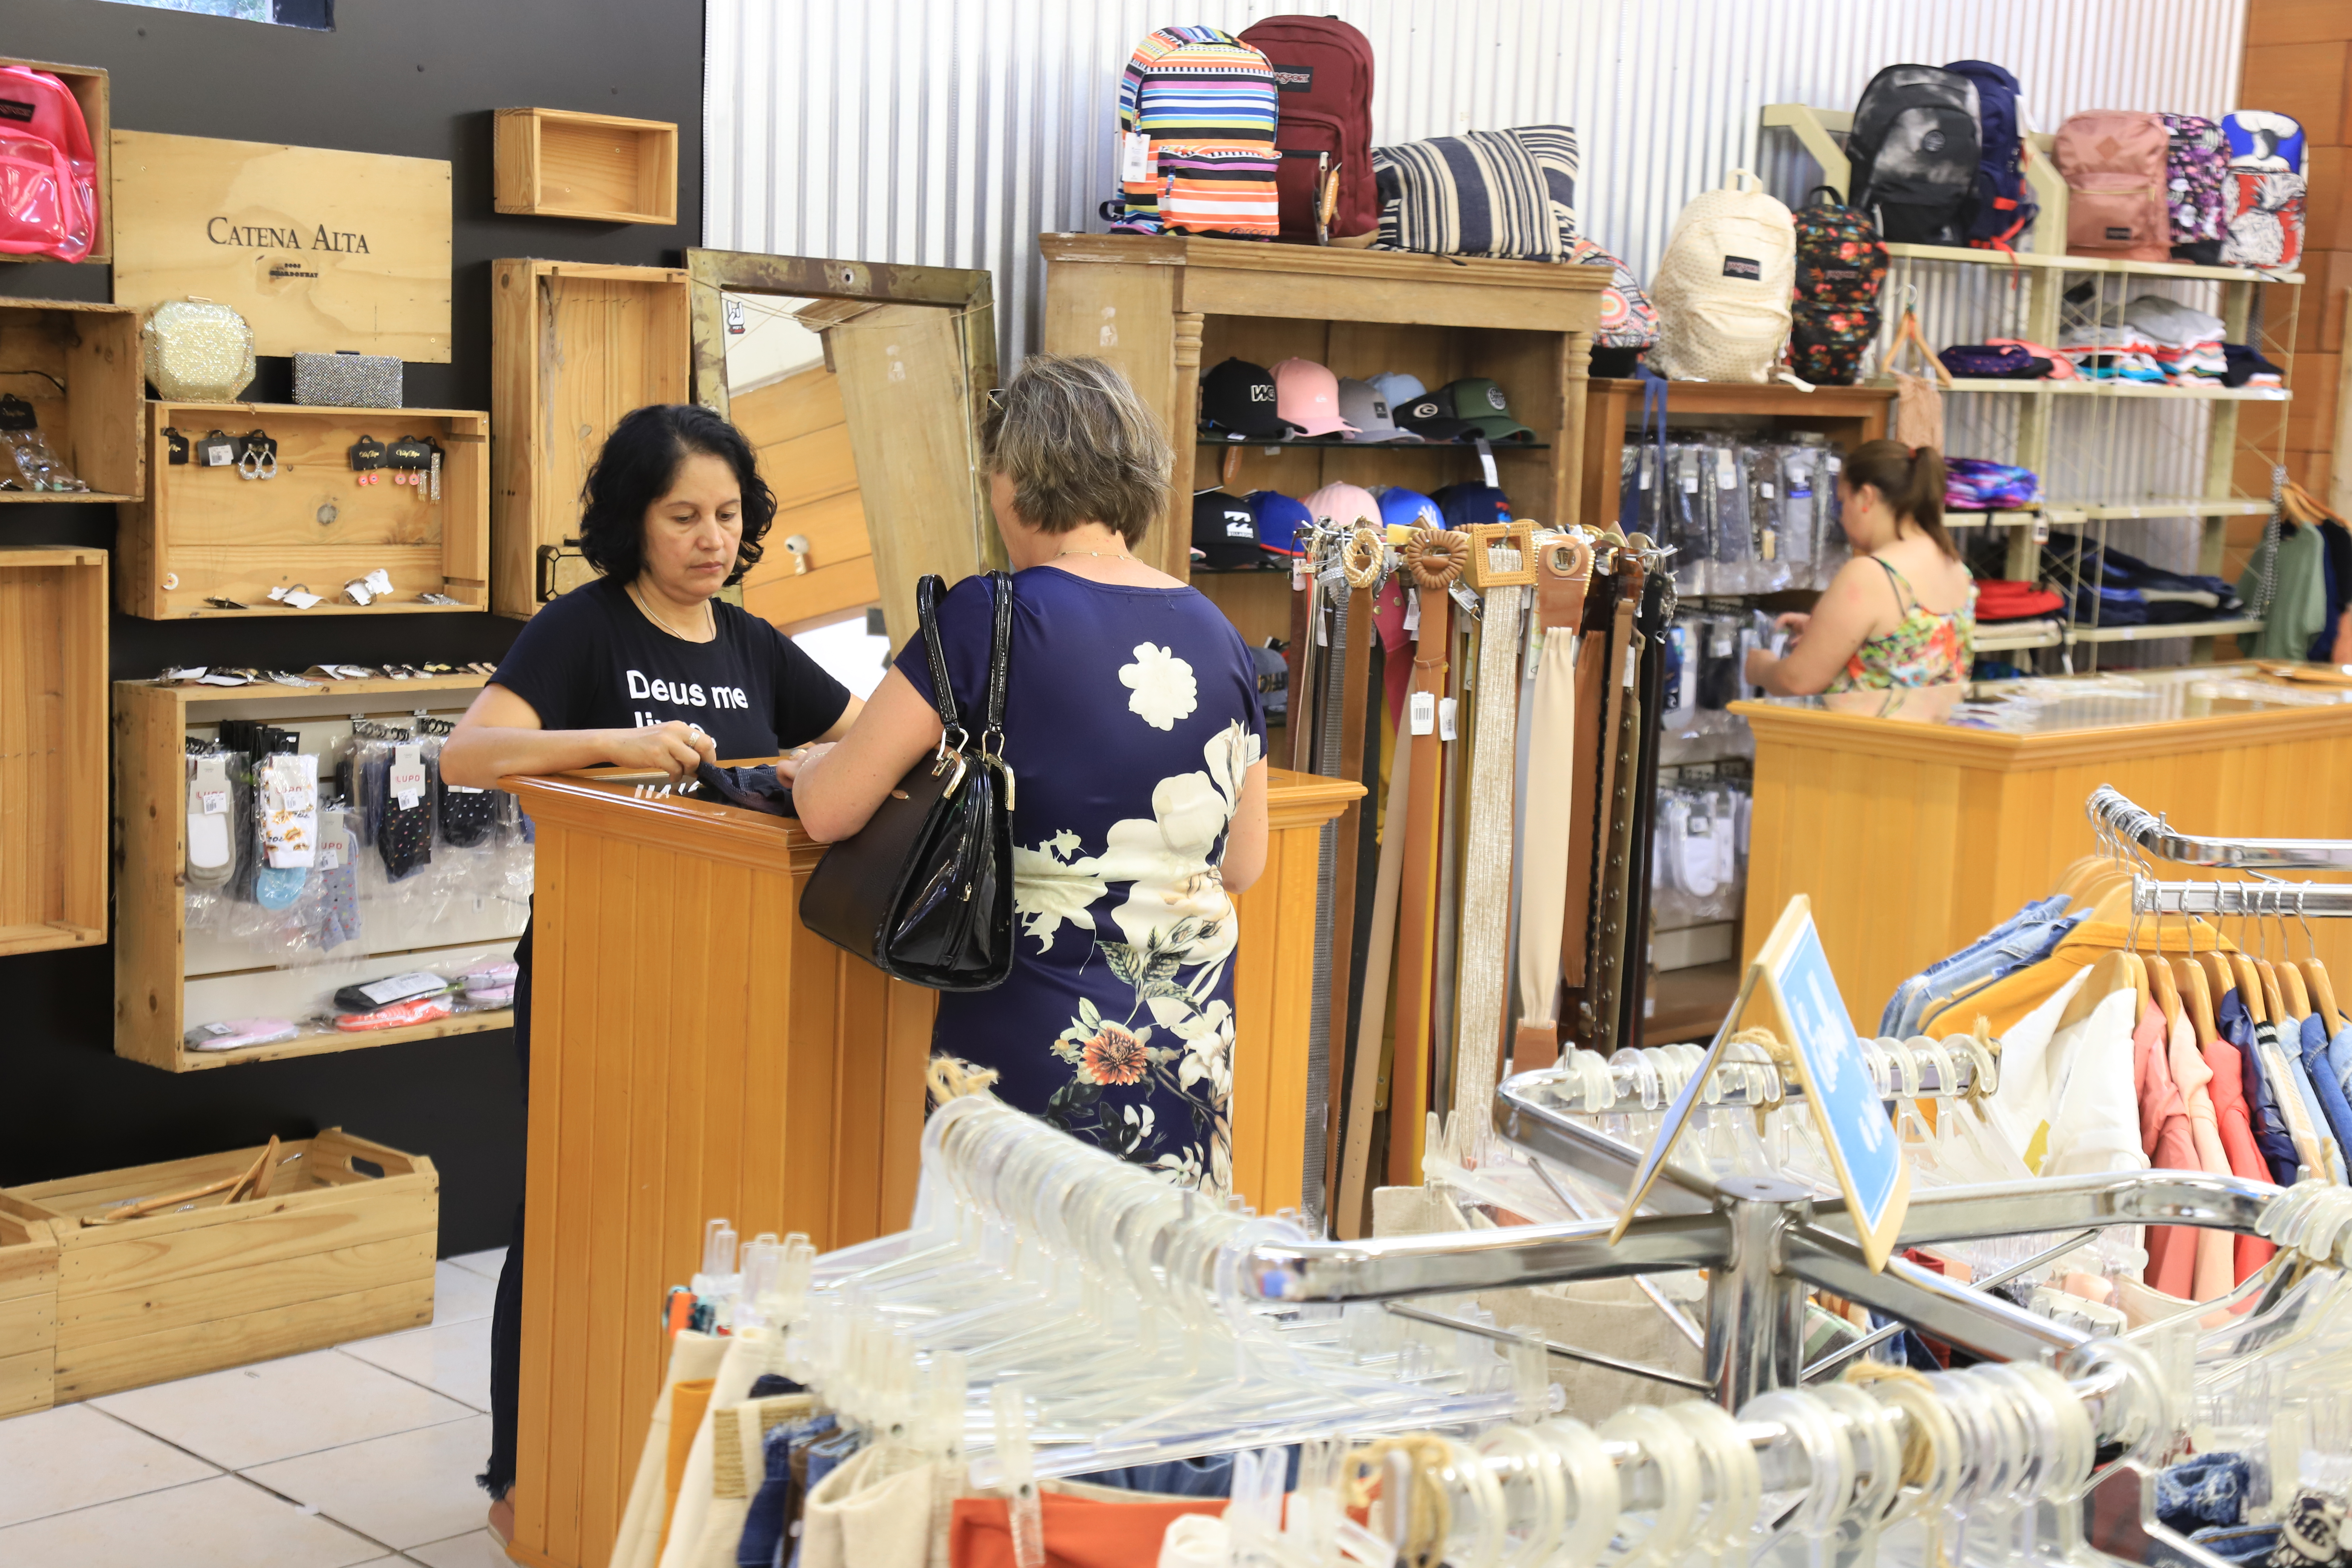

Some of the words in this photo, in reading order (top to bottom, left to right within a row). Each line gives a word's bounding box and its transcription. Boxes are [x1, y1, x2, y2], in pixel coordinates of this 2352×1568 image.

[1273, 72, 1310, 84] NSPORT
[207, 217, 301, 249] CATENA
[311, 224, 370, 254] ALTA
[626, 670, 707, 706] Deus
[711, 686, 749, 709] me
[396, 775, 420, 784] LUPO
